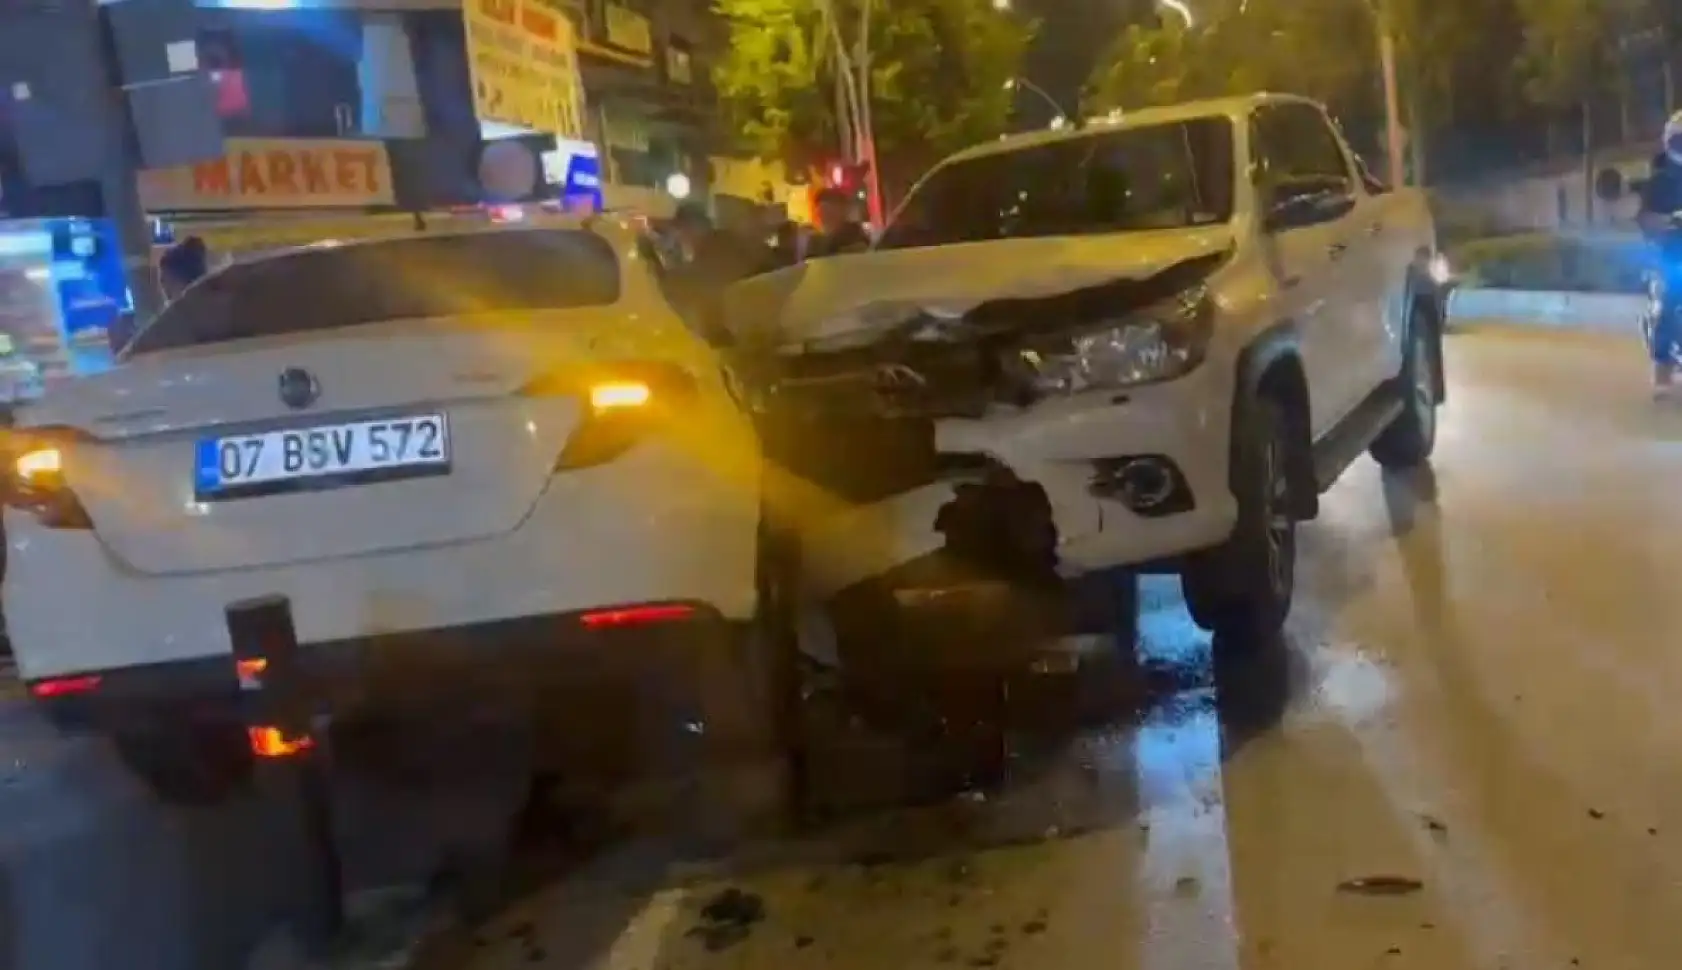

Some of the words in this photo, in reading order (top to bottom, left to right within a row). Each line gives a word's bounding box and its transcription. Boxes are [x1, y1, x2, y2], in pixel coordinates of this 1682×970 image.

[193, 147, 380, 195] MARKET
[220, 439, 264, 479] 07
[283, 429, 354, 473] BSV
[368, 419, 441, 462] 572
